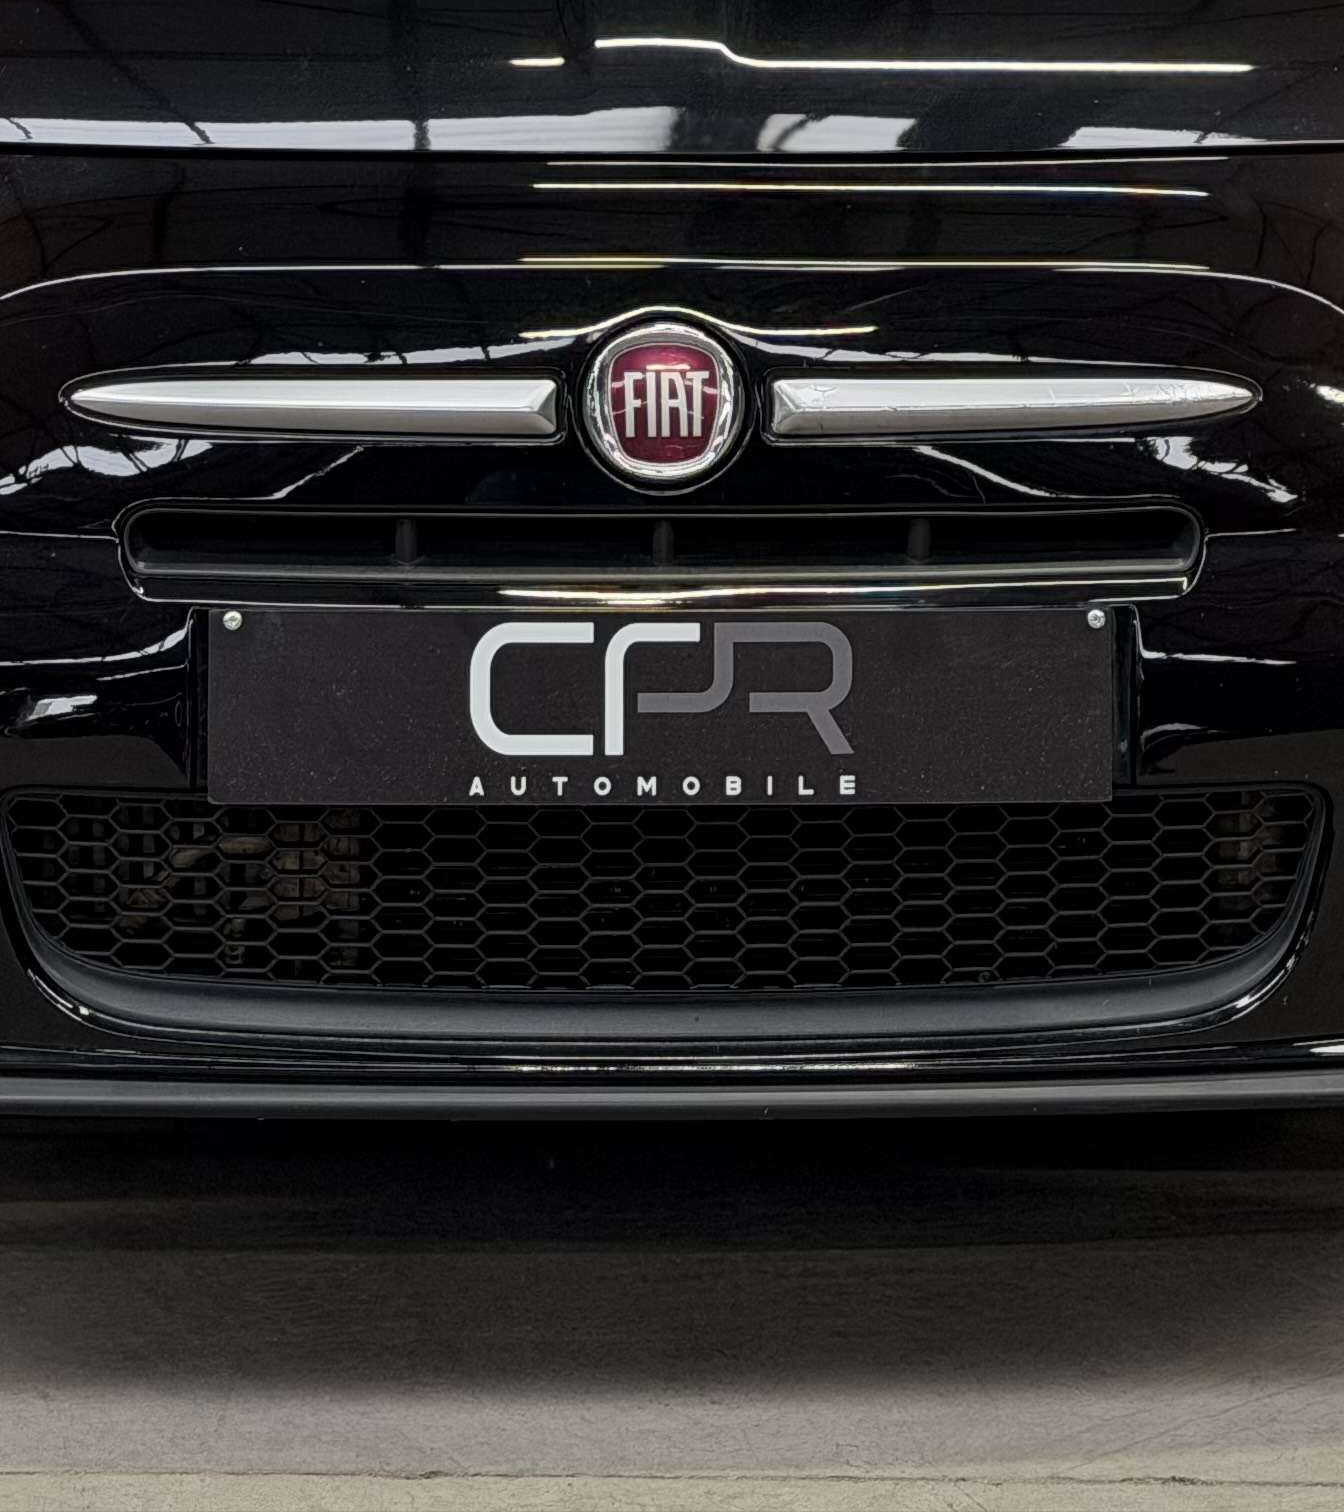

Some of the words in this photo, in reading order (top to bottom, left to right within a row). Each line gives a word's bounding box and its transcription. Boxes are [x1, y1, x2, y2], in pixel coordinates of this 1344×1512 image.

[623, 371, 710, 438] FIAT
[469, 621, 854, 756] CPR
[469, 775, 856, 796] AUTOMOBILE
